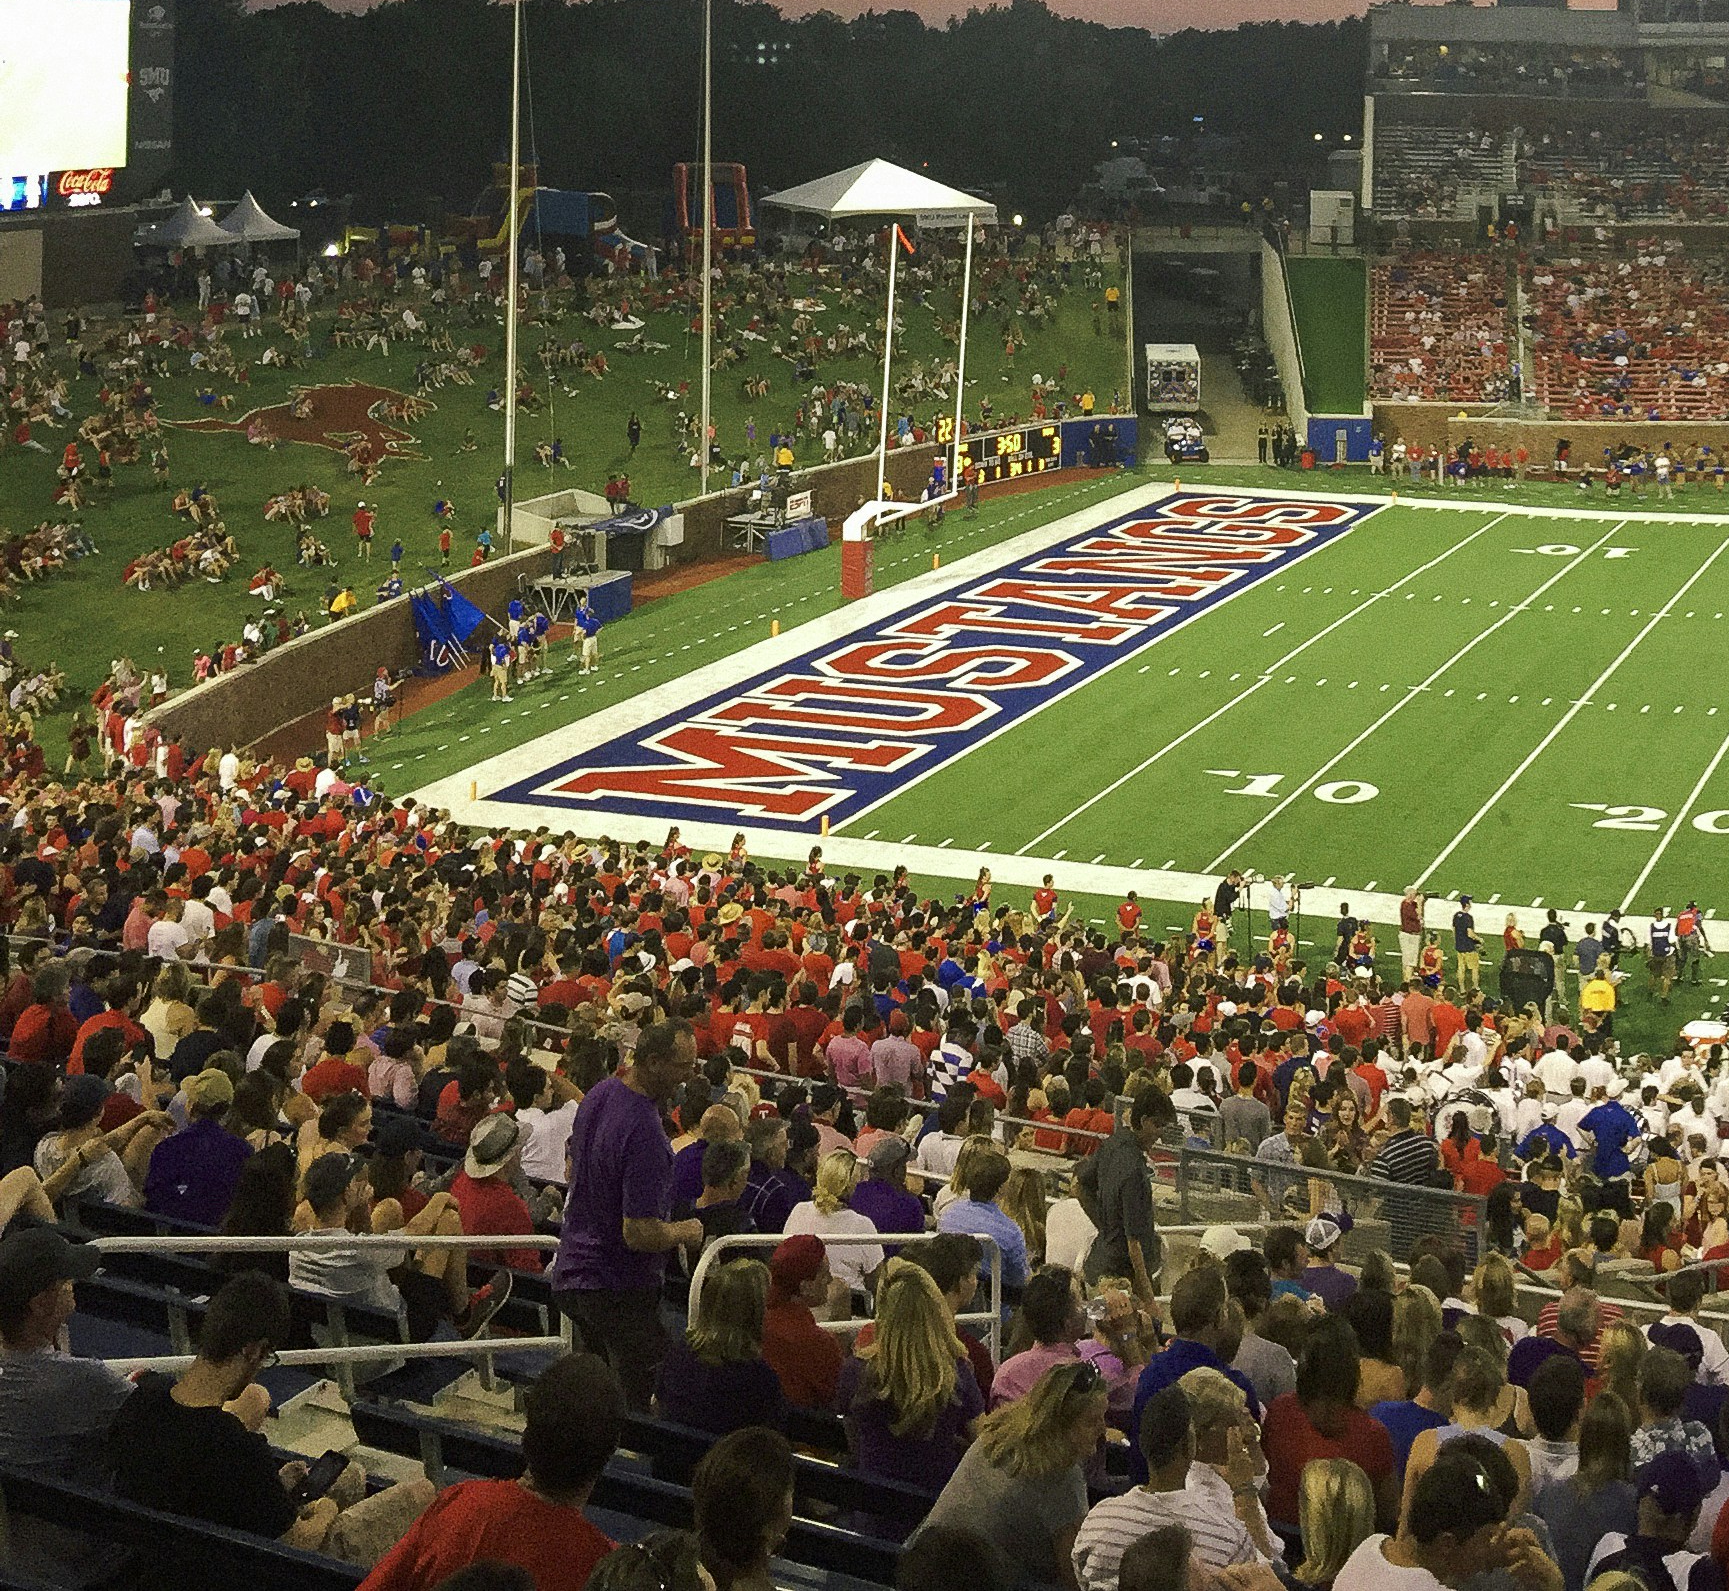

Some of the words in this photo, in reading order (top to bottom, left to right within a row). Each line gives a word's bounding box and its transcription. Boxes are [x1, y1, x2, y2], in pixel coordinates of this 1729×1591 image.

[139, 67, 170, 86] SMU
[790, 496, 809, 510] ESPN
[1536, 543, 1640, 559] 10
[530, 496, 1360, 823] MUSTANGS
[1224, 773, 1380, 804] 10
[759, 1110, 769, 1120] T
